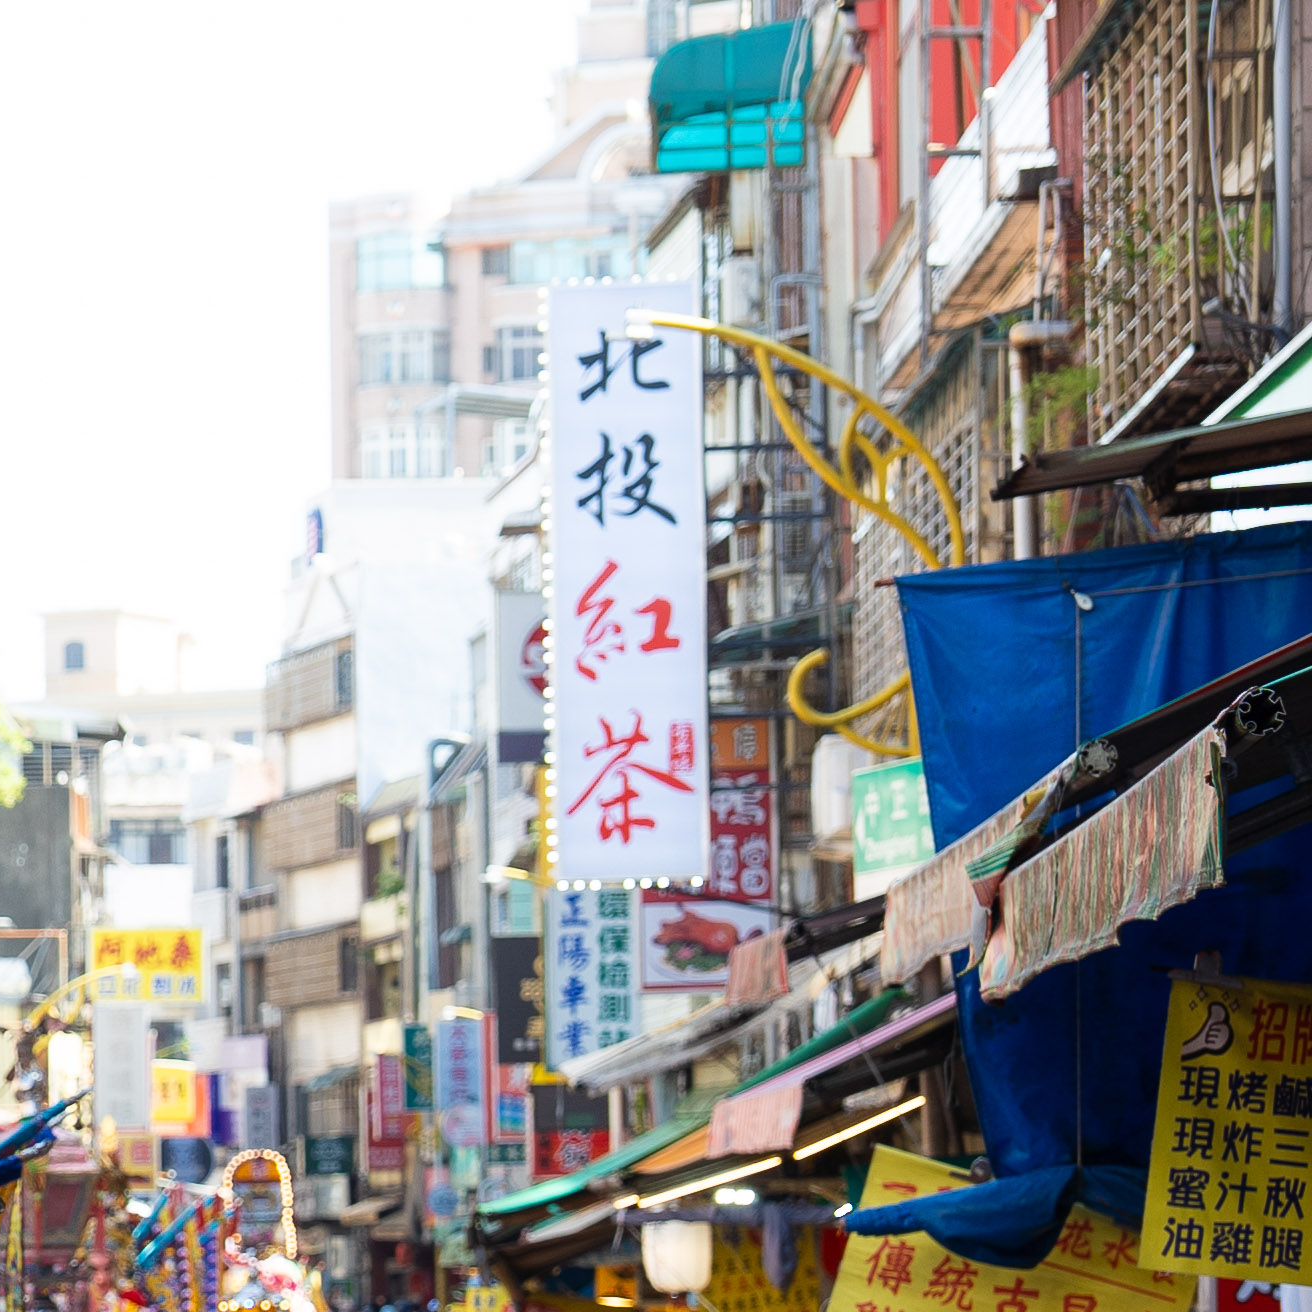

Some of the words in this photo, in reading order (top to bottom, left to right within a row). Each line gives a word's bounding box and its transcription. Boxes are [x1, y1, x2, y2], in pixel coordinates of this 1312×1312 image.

[566, 328, 696, 845] 北投紅茶
[1171, 1117, 1311, 1168] 現炸三
[1167, 1167, 1307, 1221] 蜜汁秋
[1161, 1217, 1304, 1271] 油雞腿
